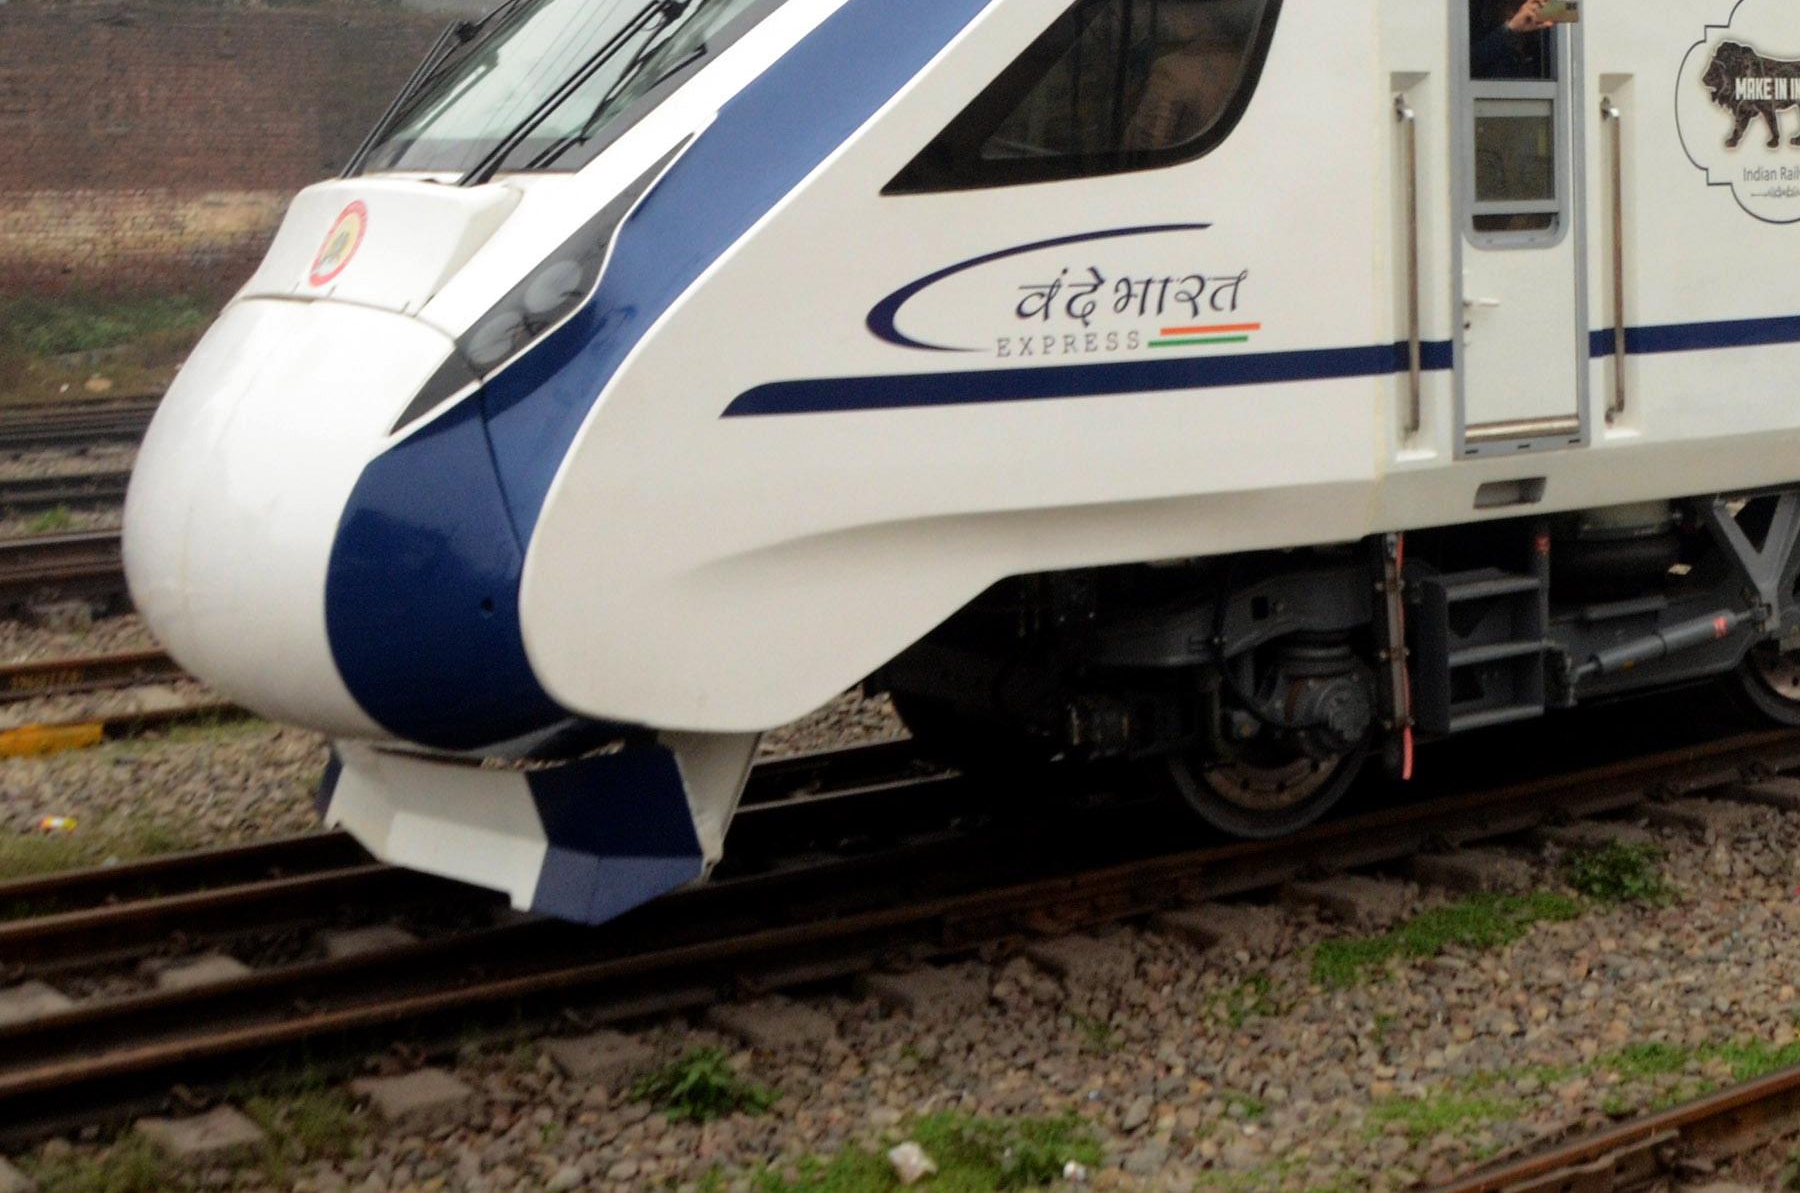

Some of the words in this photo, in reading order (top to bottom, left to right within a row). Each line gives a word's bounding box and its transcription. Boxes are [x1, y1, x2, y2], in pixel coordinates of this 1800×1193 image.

[1735, 77, 1772, 101] MAKE
[1774, 77, 1788, 101] IN
[1743, 166, 1777, 182] Indian
[1015, 267, 1105, 327] वंदे
[1113, 269, 1248, 319] भारत
[996, 330, 1141, 358] EXPRESS
